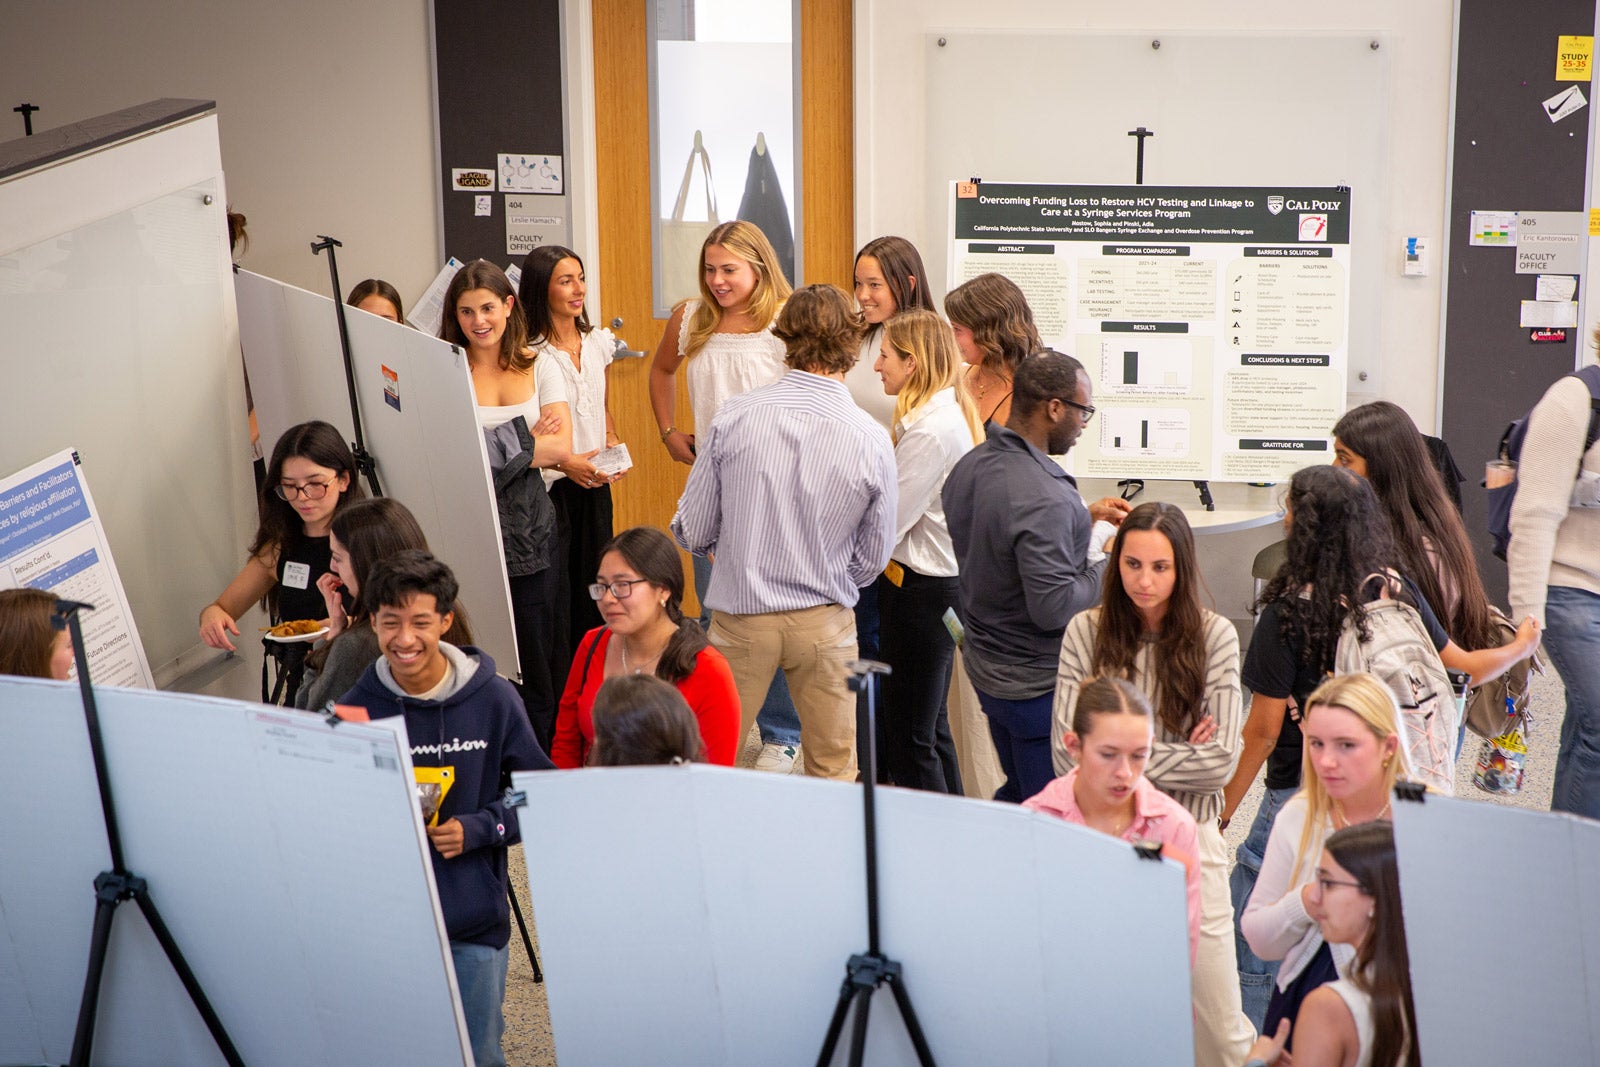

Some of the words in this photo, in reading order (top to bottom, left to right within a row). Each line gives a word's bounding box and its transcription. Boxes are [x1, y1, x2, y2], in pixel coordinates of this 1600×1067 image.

[980, 196, 1030, 206] Overcoming
[1033, 197, 1067, 206] Funding
[1069, 198, 1087, 206] Loss
[1101, 198, 1134, 206] Restore
[1157, 198, 1188, 208] Testing
[1190, 199, 1206, 207] and
[1209, 199, 1242, 208] Linkage
[1286, 200, 1310, 210] CAL
[1312, 200, 1341, 210] POLY
[1082, 209, 1113, 218] Syringe
[1155, 210, 1190, 218] Program
[0, 492, 26, 511] Barriers
[26, 484, 39, 498] and
[39, 470, 74, 491] Facilitators
[10, 512, 19, 524] by
[19, 500, 48, 519] religious
[48, 486, 76, 506] affiliation
[14, 560, 34, 574] Results
[86, 646, 104, 659] Future
[103, 632, 128, 649] Directions
